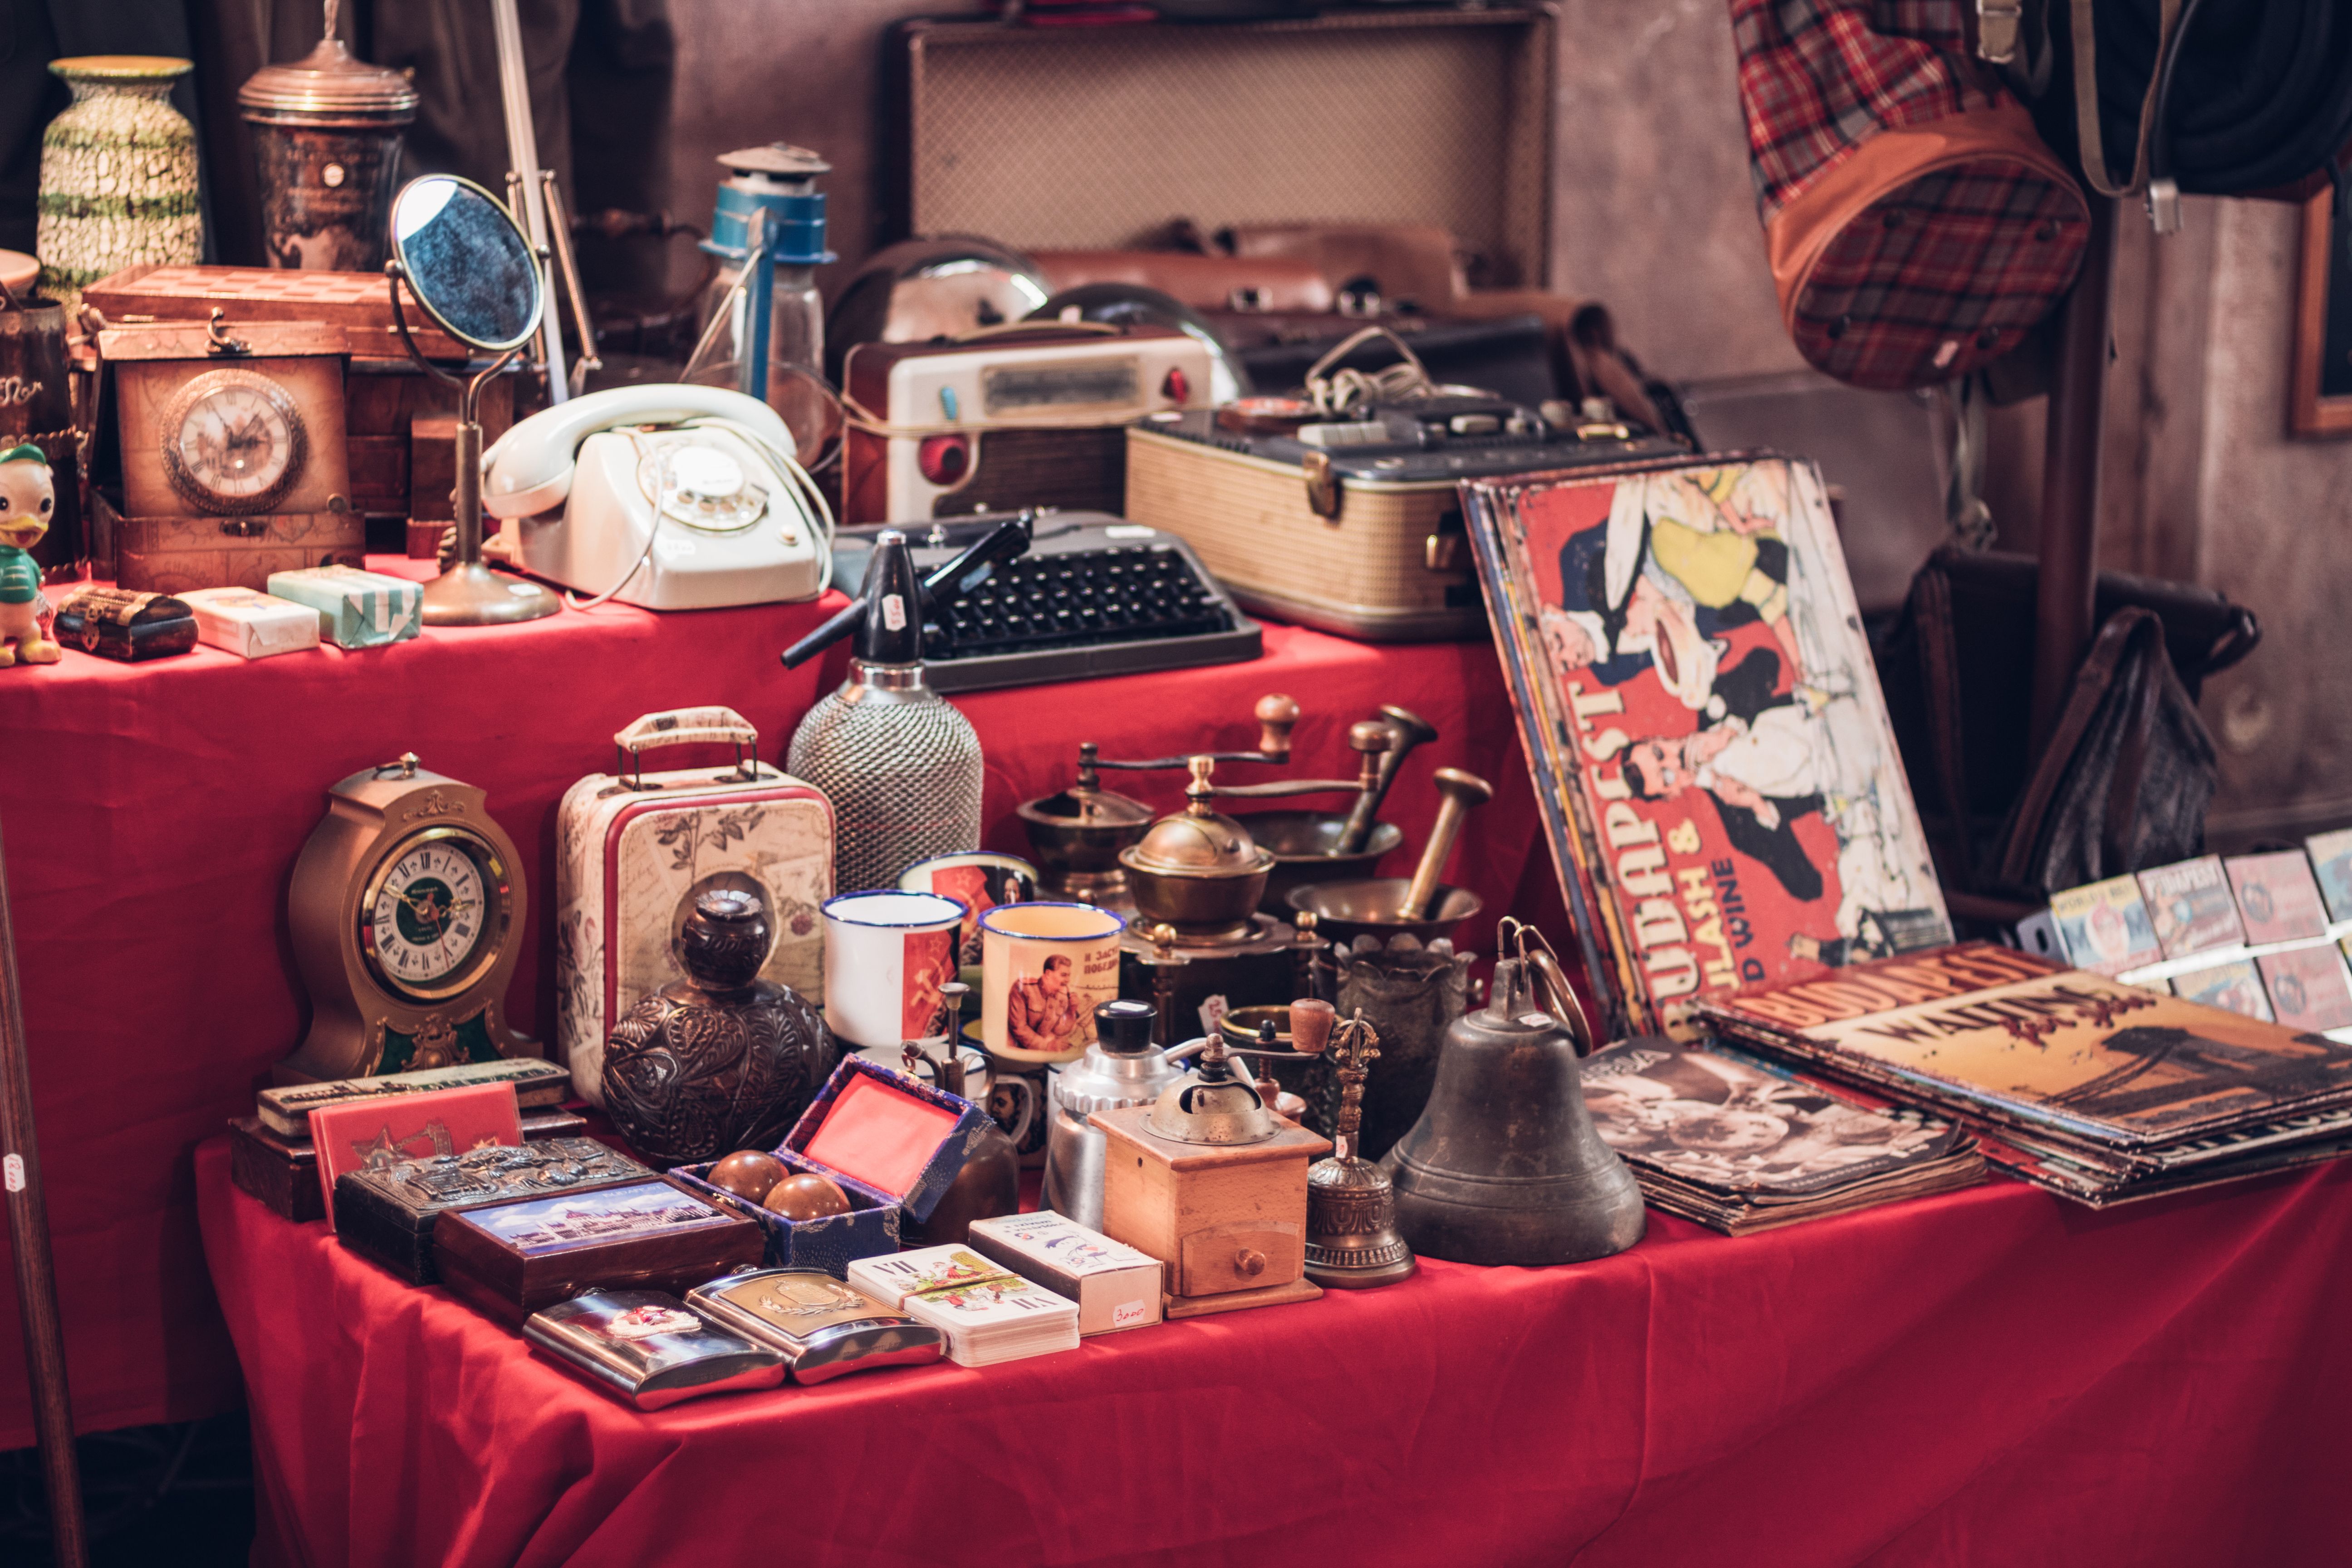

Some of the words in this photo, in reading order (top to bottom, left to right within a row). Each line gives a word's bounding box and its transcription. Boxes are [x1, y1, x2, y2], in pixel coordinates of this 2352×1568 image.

[1667, 818, 1702, 855] &
[1711, 858, 1754, 949] WINE
[1731, 945, 2057, 1028] BUDAPEST
[871, 1260, 921, 1276] VII
[1116, 1308, 1144, 1322] 3000
